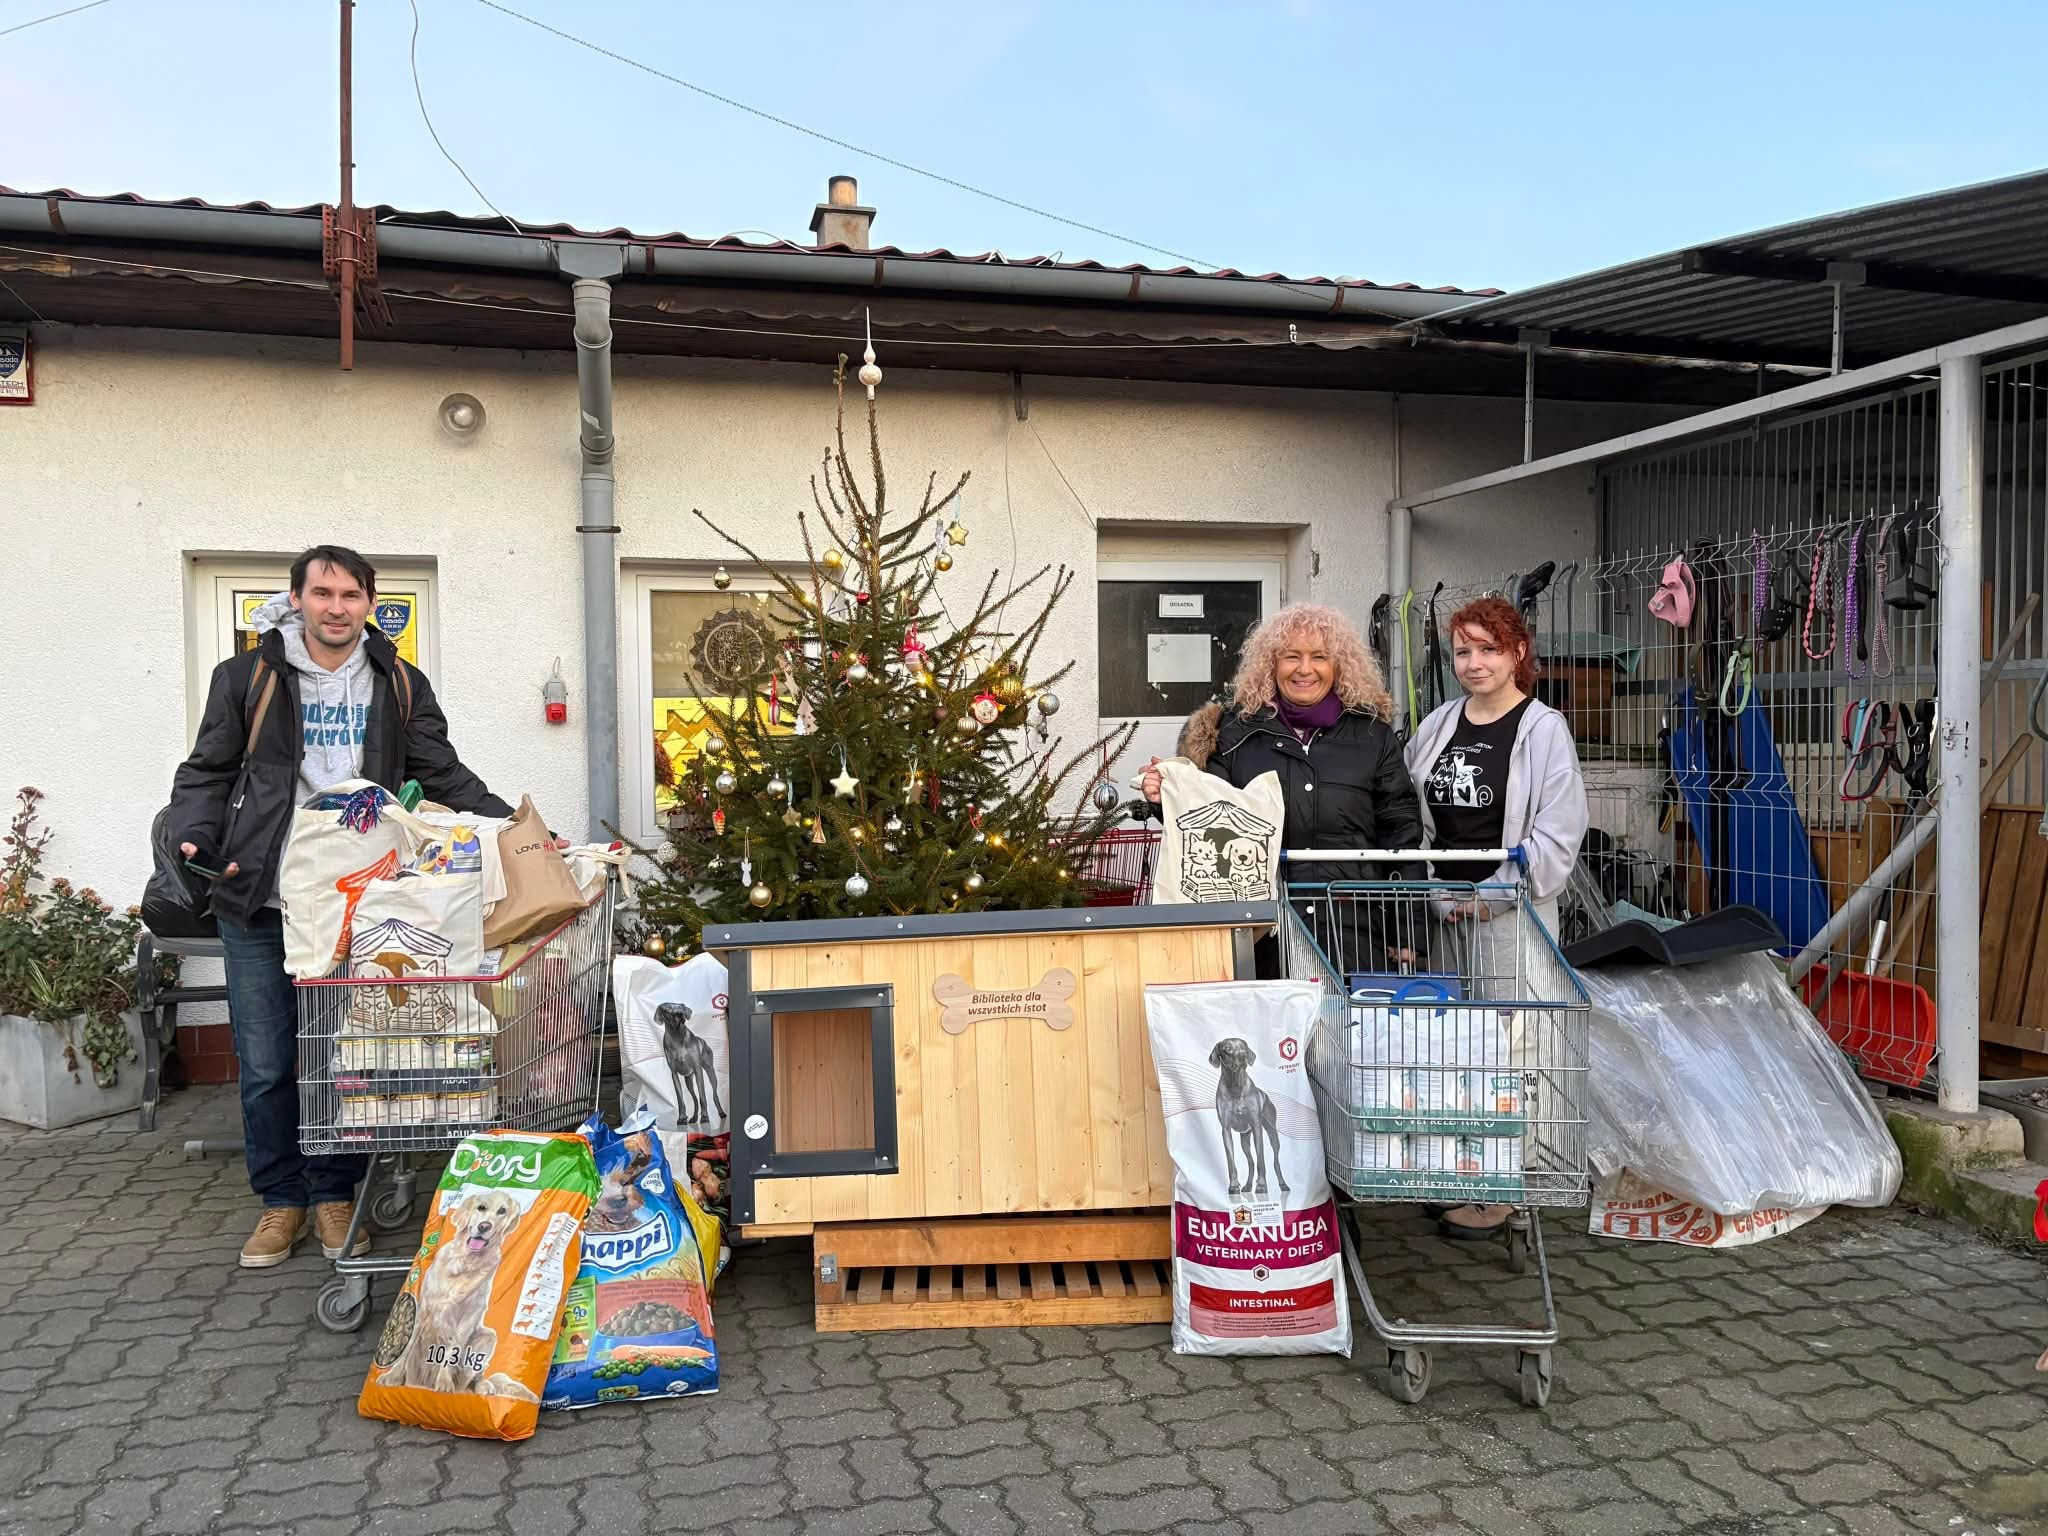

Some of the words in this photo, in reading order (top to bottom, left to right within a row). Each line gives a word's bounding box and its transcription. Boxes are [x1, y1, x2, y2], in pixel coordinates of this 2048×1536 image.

[515, 843, 541, 854] LOVE
[972, 993, 1022, 1004] Biblioteka
[1025, 992, 1041, 1001] dla
[1023, 1003, 1046, 1012] istot
[1188, 1215, 1328, 1243] EUKANUBA
[581, 1223, 662, 1261] happi
[1196, 1243, 1283, 1259] VETERINARY
[1288, 1241, 1324, 1257] DIETS
[1229, 1298, 1297, 1308] INTESTINAL
[426, 1345, 460, 1368] 10,3
[464, 1347, 486, 1371] kg
